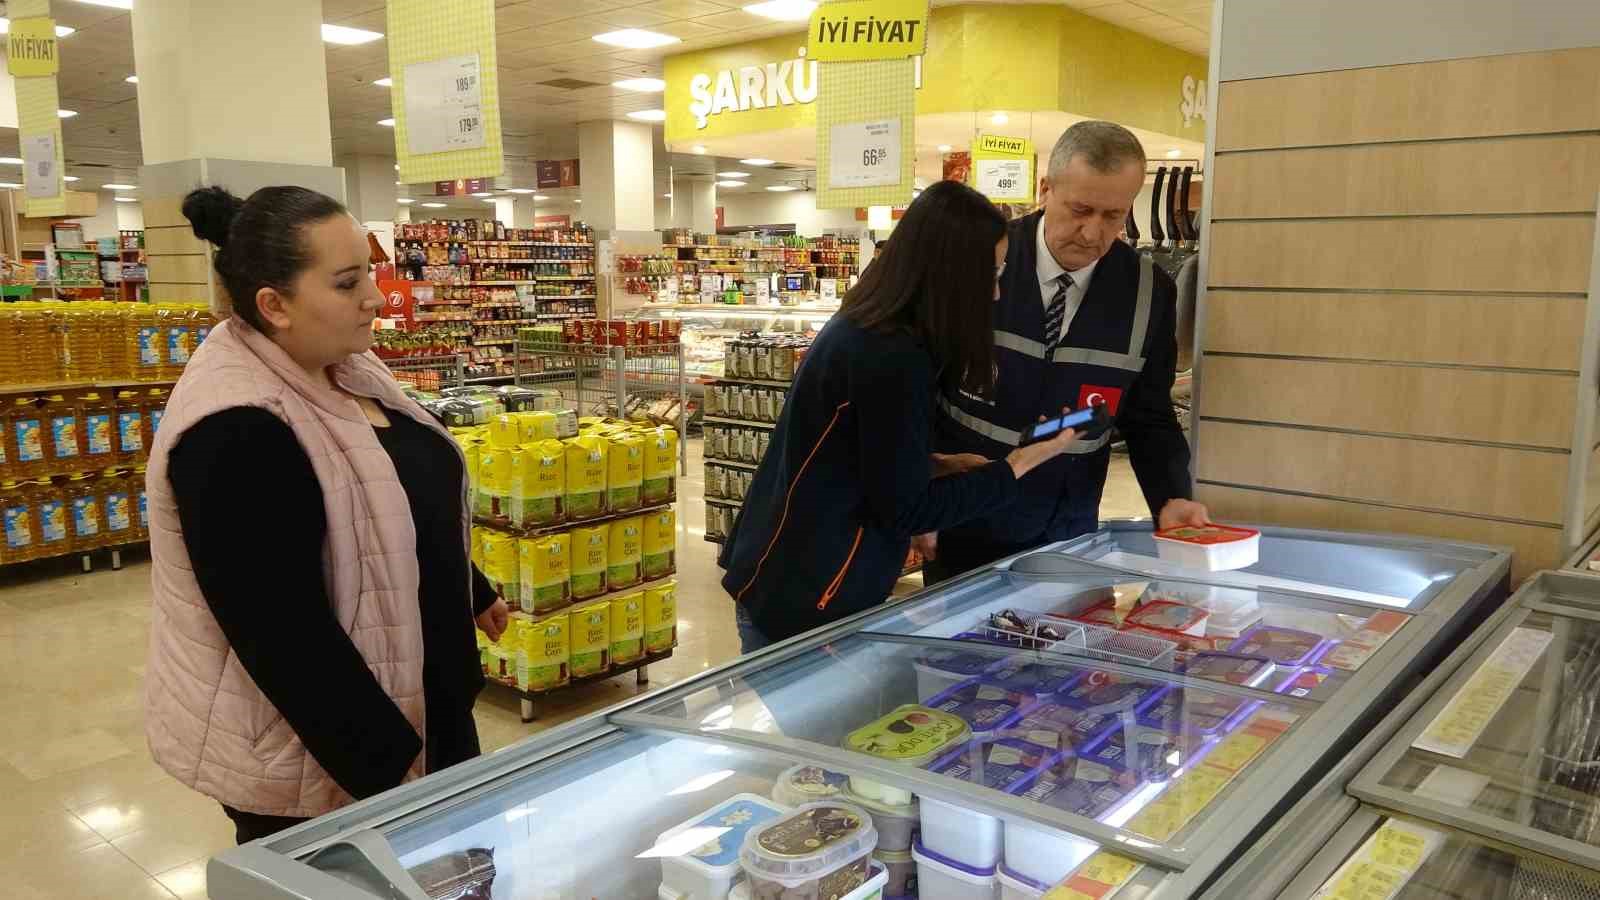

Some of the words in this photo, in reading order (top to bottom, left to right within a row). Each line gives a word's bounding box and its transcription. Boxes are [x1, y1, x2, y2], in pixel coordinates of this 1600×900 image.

[817, 16, 848, 43] İYİ
[852, 15, 921, 43] FİYAT
[26, 34, 54, 61] FİYAT
[985, 135, 998, 148] İYİ
[998, 139, 1021, 150] FİYAT
